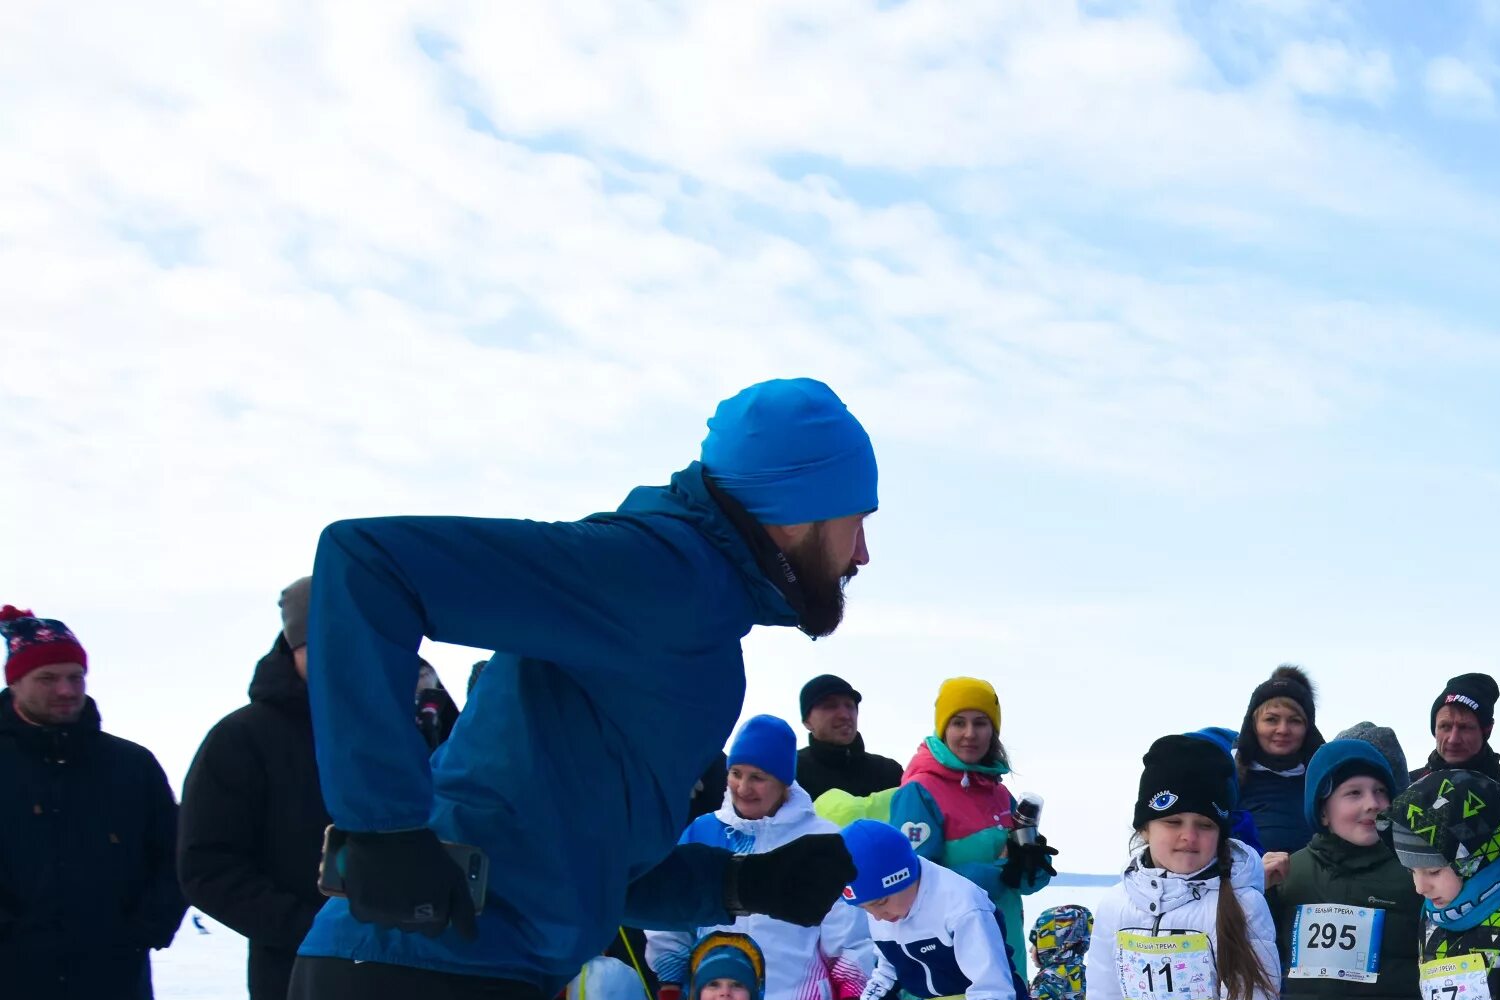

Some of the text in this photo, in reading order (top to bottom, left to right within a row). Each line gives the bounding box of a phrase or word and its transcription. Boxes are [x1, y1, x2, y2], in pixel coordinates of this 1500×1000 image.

[1334, 908, 1354, 916] ТРЕЙЛ
[1307, 922, 1357, 951] 295
[1142, 963, 1173, 992] 11
